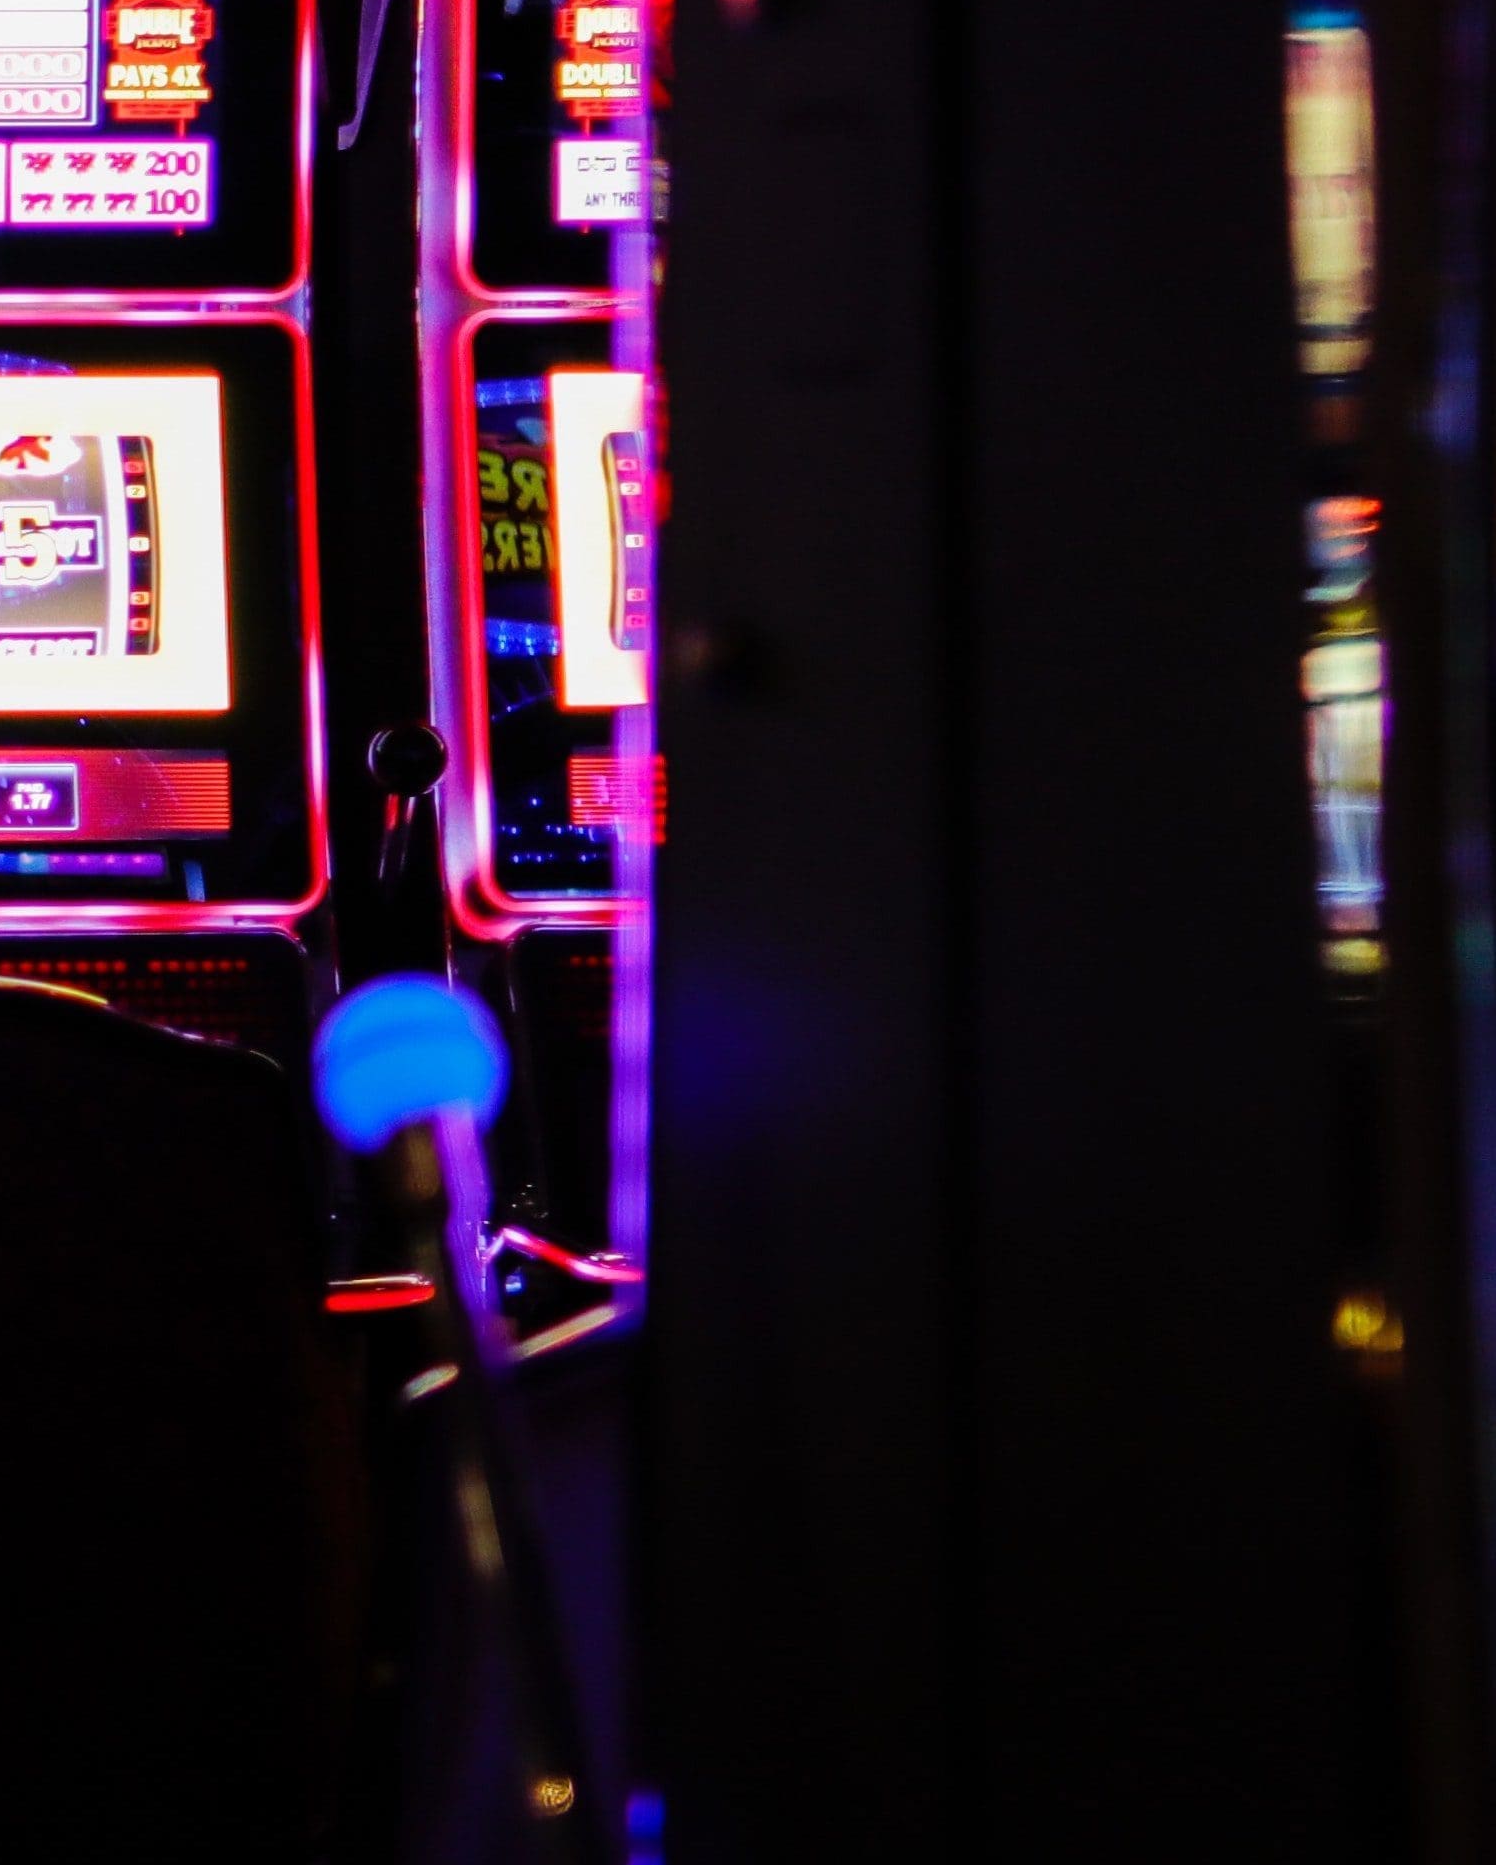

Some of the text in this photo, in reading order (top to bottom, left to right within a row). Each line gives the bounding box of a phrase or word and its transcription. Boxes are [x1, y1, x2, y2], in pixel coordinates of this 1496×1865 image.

[576, 7, 639, 42] DOUBL
[110, 64, 202, 87] PAYS 4X
[562, 62, 641, 86] DOUBL
[144, 150, 200, 177] 200
[145, 188, 200, 215] 100
[584, 192, 606, 207] ANY
[3, 505, 57, 580] 5
